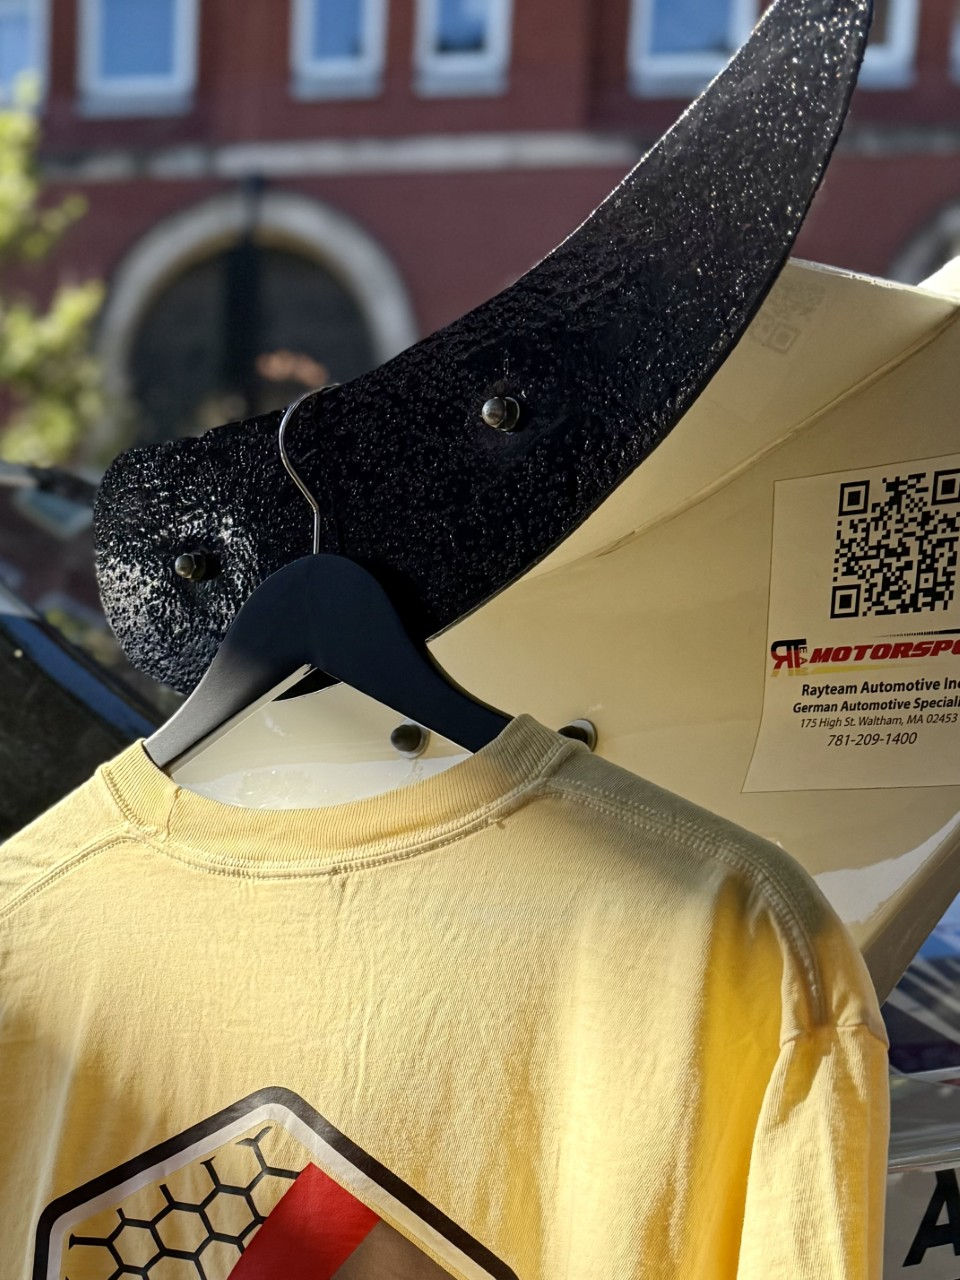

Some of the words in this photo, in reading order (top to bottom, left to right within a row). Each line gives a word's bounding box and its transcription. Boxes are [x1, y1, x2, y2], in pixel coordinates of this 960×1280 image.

[802, 684, 857, 698] Rayteam
[860, 678, 940, 694] Automotive
[793, 702, 838, 713] German
[840, 699, 910, 712] Automotive
[800, 718, 817, 728] 175
[819, 716, 842, 729] High
[858, 714, 904, 727] Waltham,
[906, 715, 924, 725] MA
[926, 713, 958, 724] 02453
[827, 732, 917, 746] 781-209-1400
